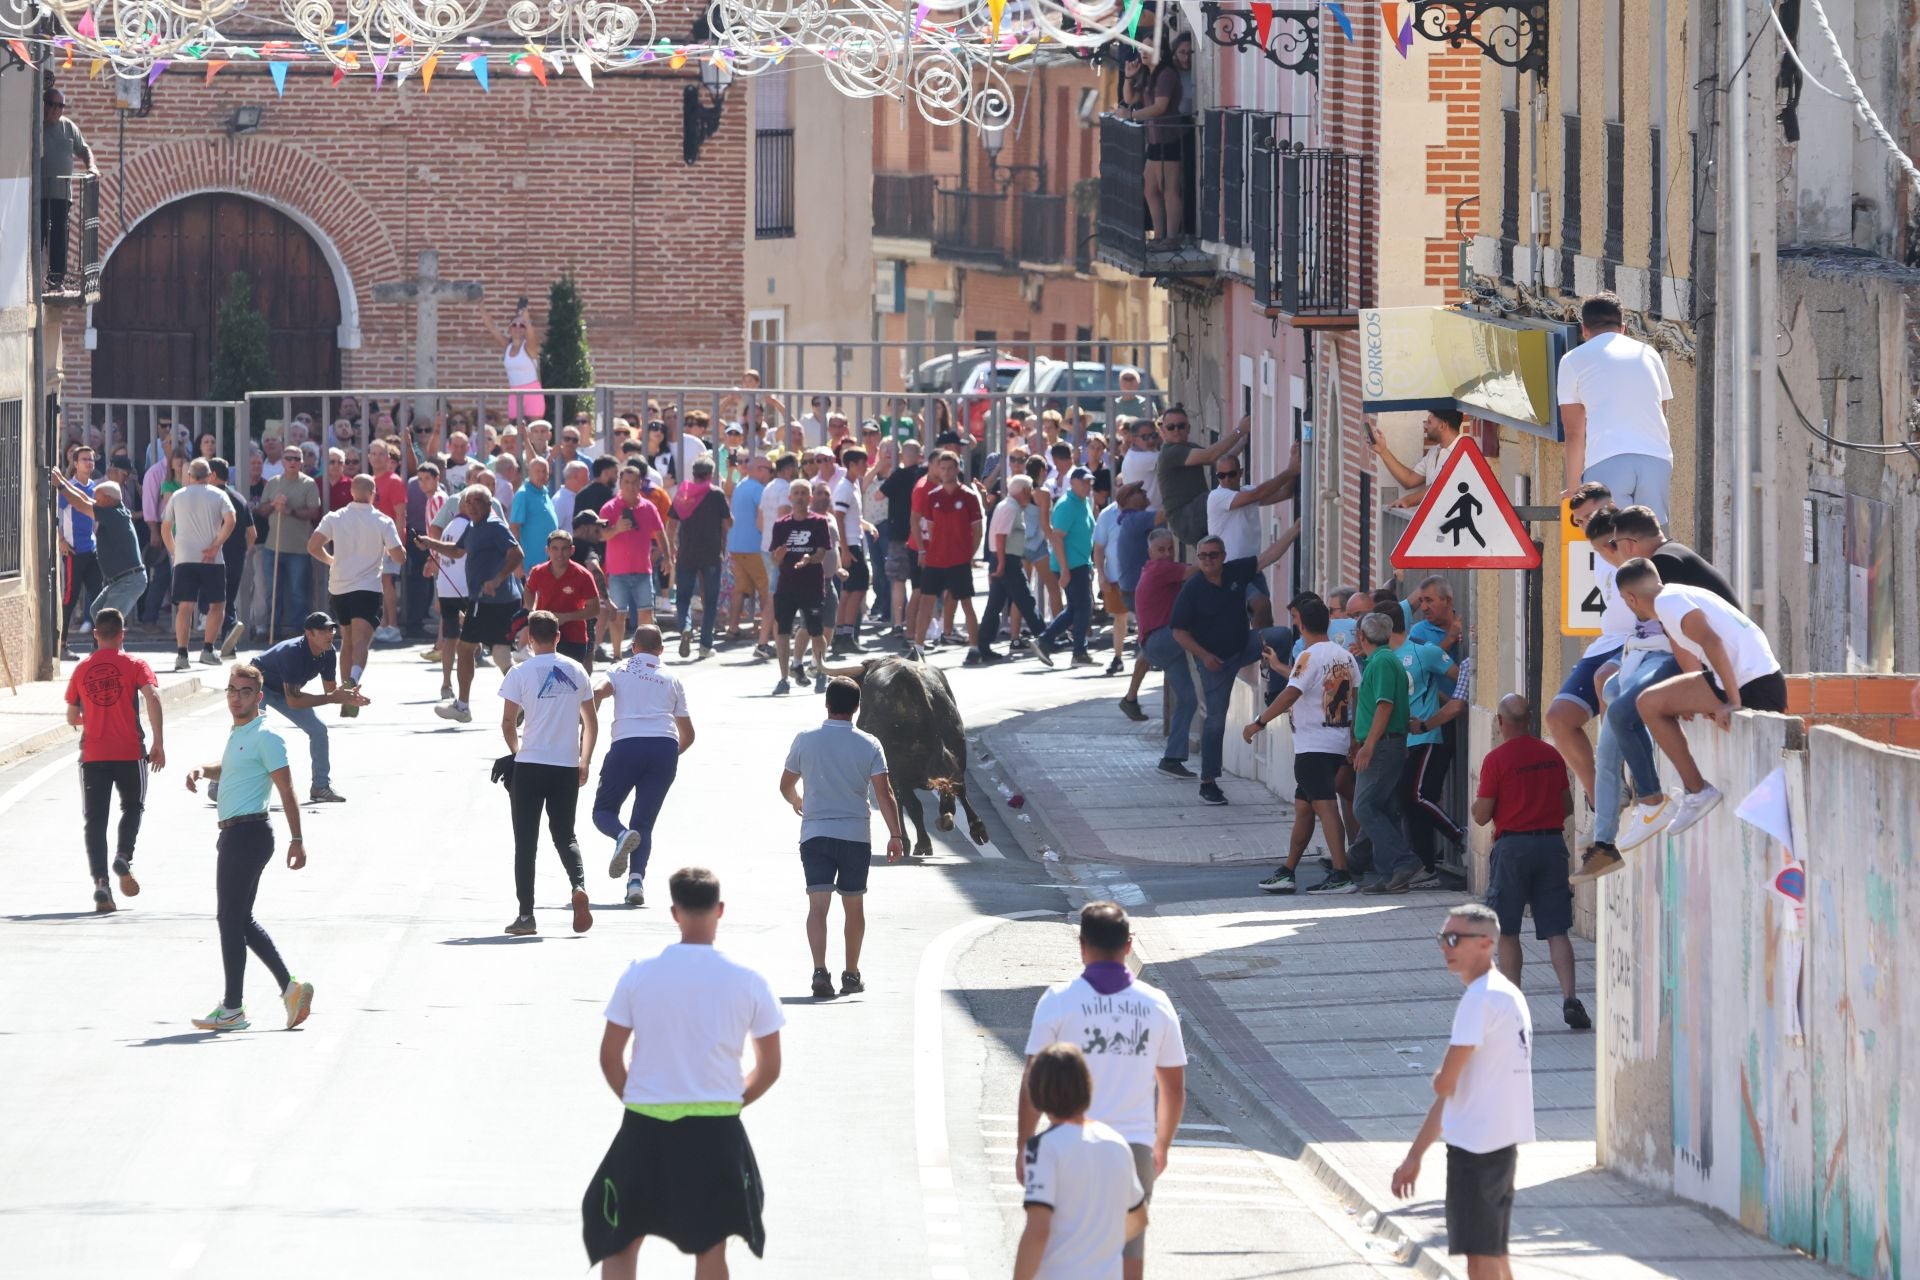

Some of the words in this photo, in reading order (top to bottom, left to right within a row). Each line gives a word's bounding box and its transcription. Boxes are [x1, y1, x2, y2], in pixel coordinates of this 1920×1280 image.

[1365, 312, 1384, 398] CORREOS
[638, 675, 665, 686] OSCAR
[1081, 996, 1113, 1017] wild
